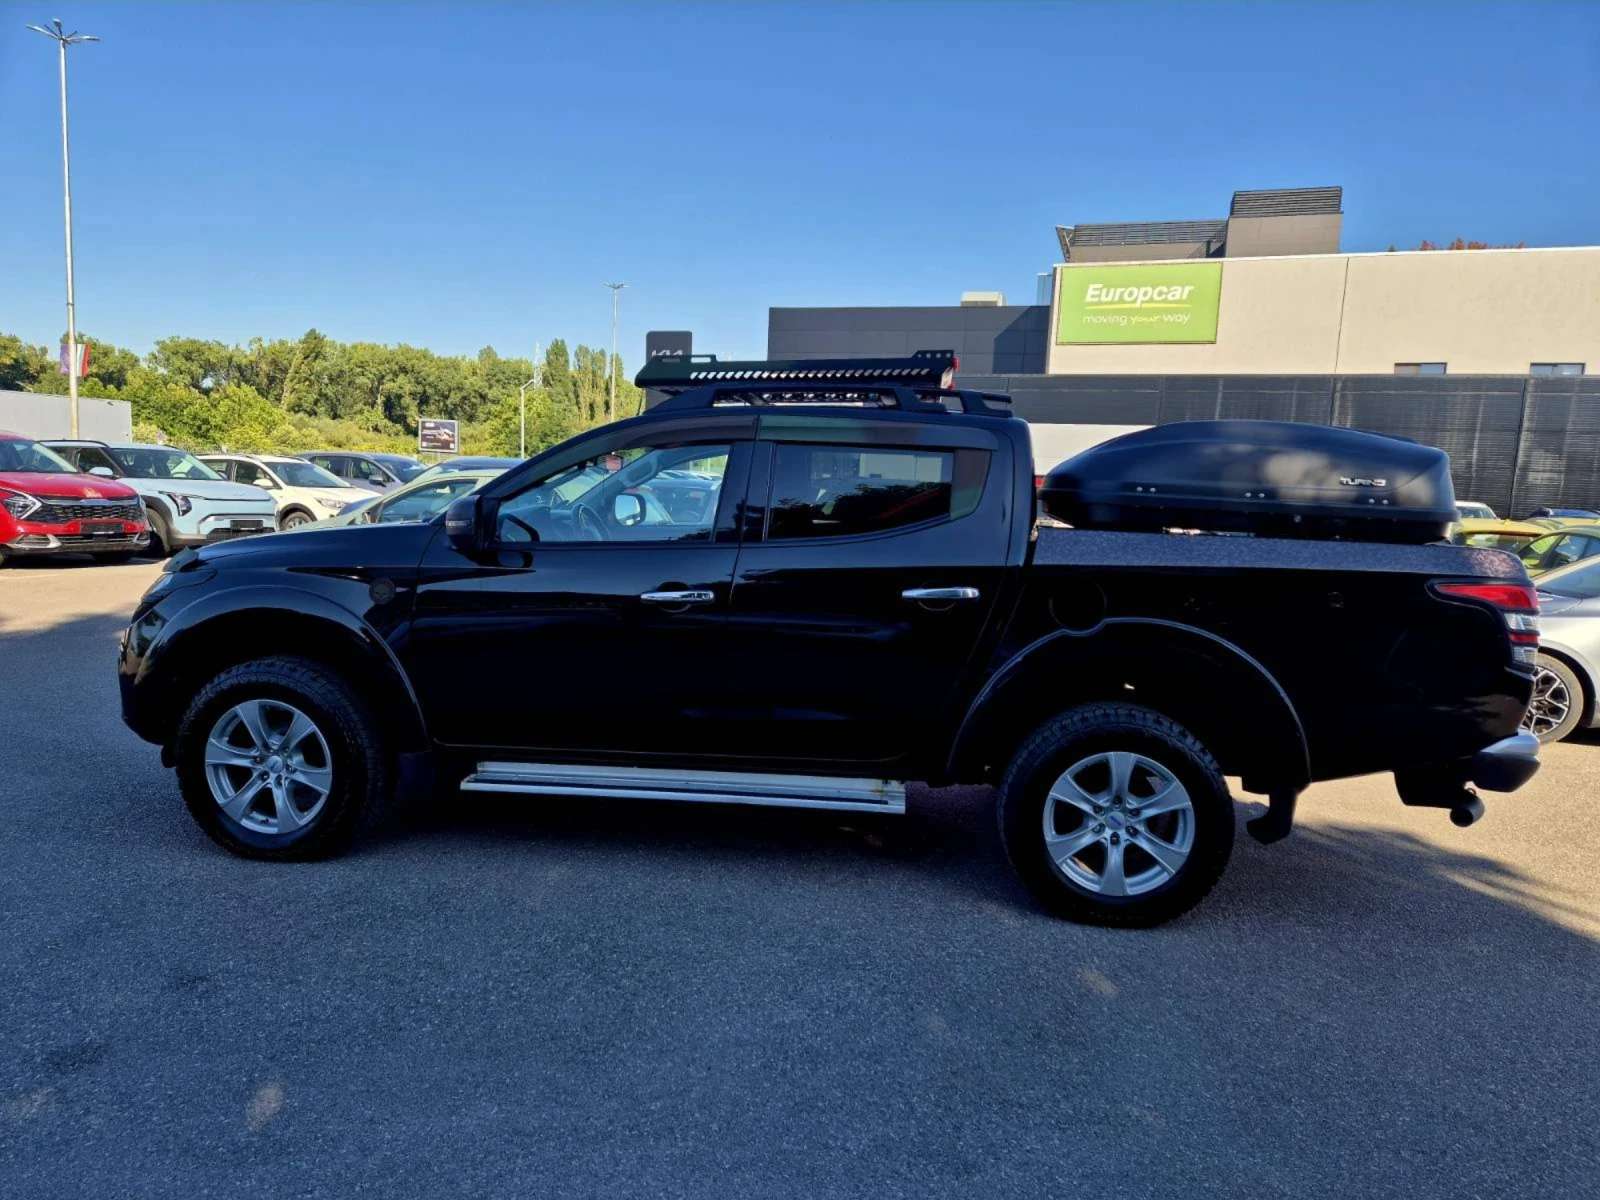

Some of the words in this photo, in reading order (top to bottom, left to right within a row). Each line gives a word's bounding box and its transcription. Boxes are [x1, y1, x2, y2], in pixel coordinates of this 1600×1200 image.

[1084, 283, 1195, 308] Europcar
[1082, 314, 1128, 326] moving
[1130, 314, 1162, 325] your
[1163, 313, 1191, 325] way
